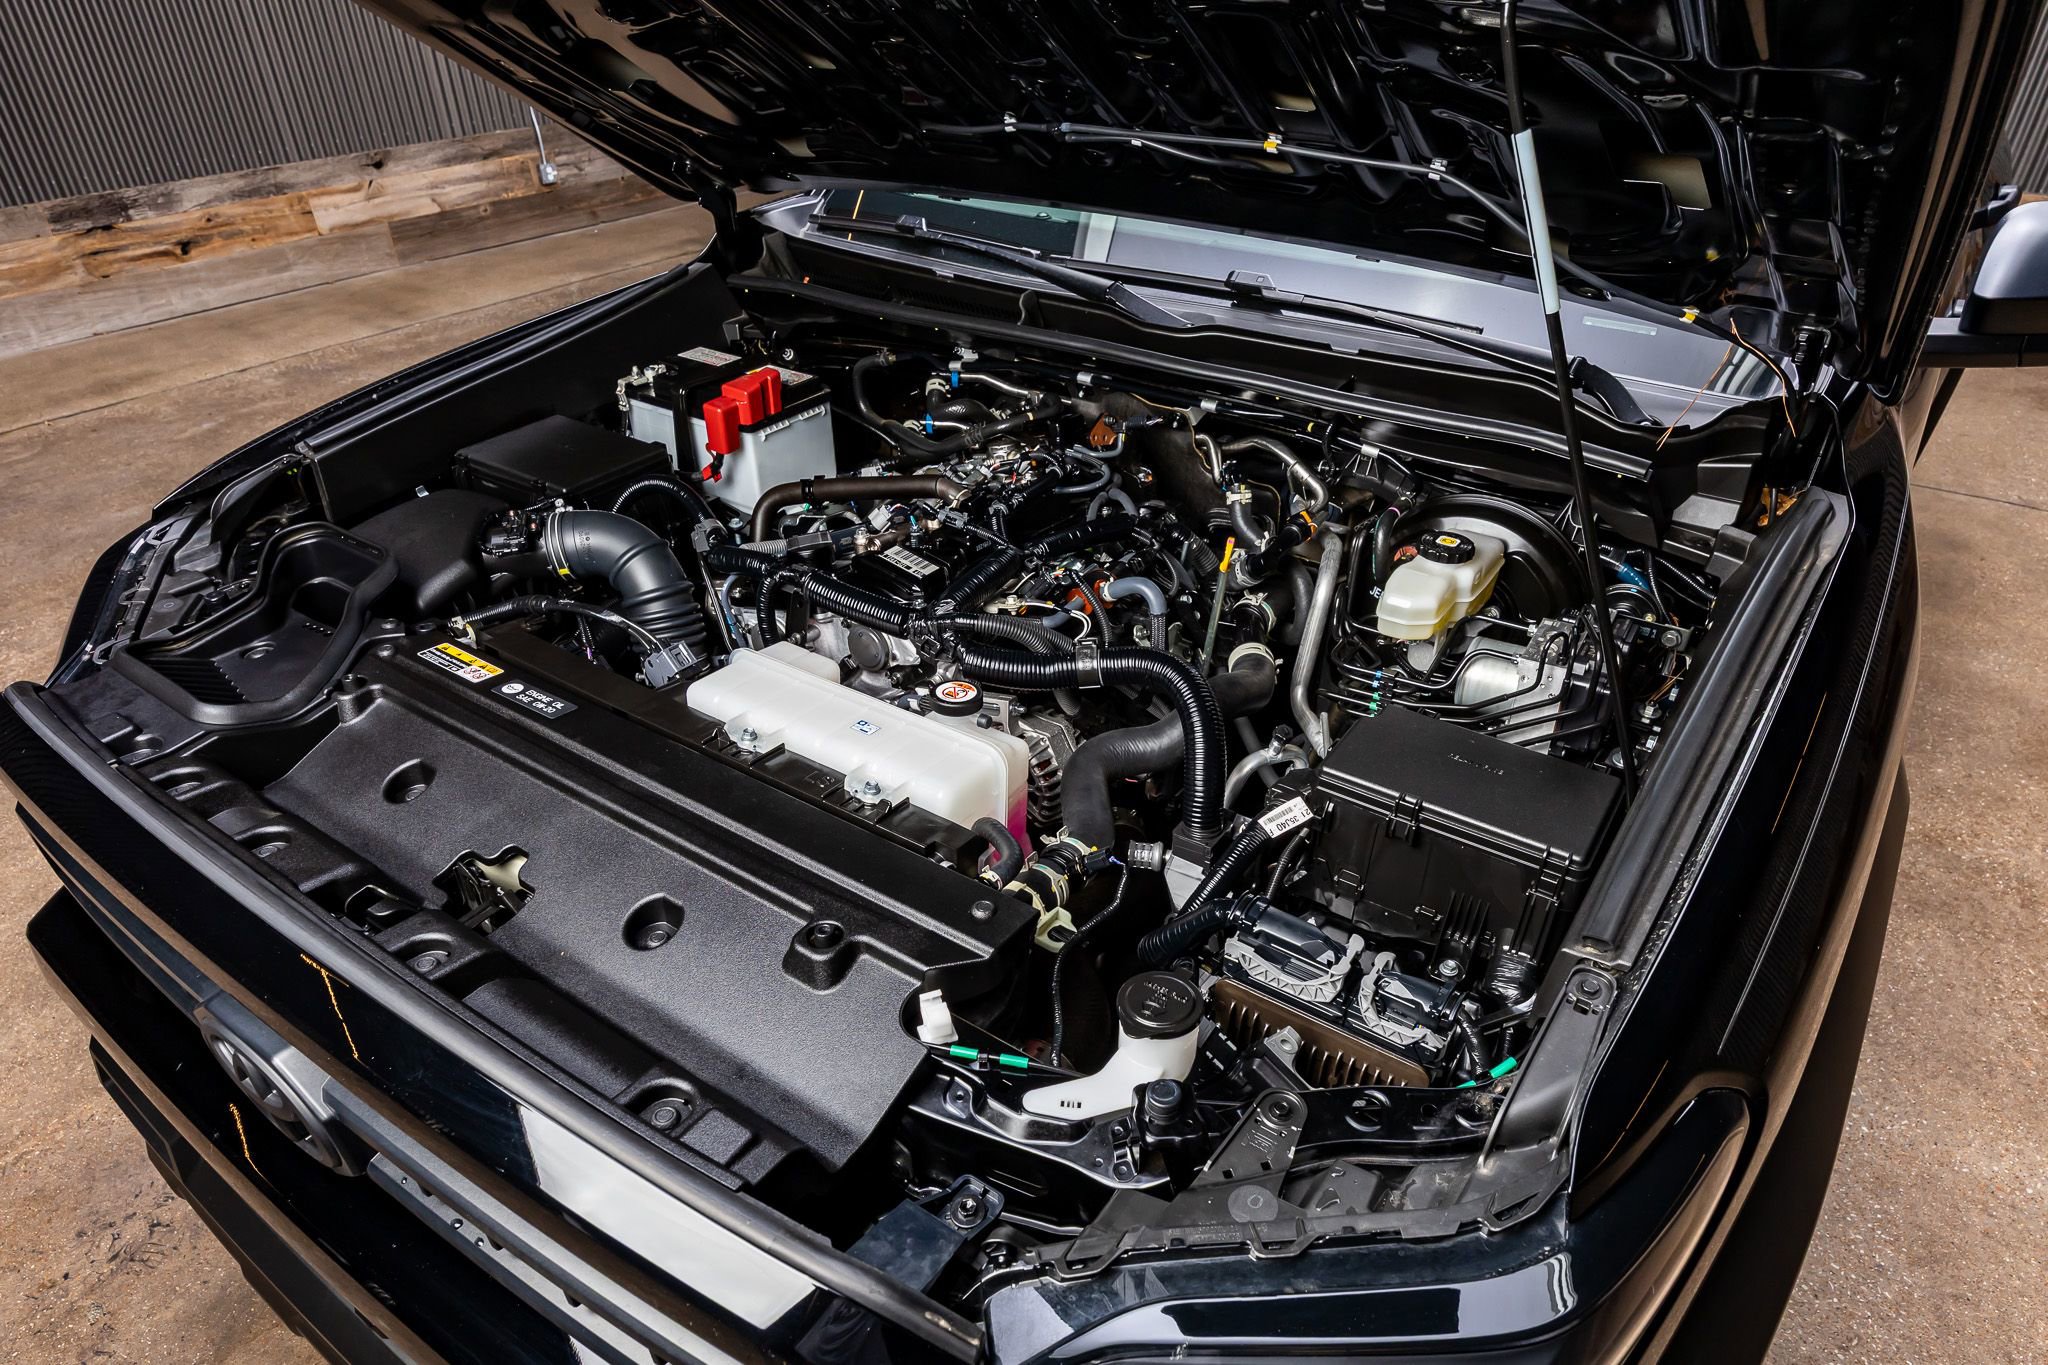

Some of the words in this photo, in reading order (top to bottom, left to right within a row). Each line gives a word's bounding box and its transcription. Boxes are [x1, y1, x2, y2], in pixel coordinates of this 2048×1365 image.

[516, 693, 534, 703] SAE
[532, 701, 556, 713] 0W-20
[525, 689, 554, 703] ENGINE
[552, 701, 565, 710] OIL
